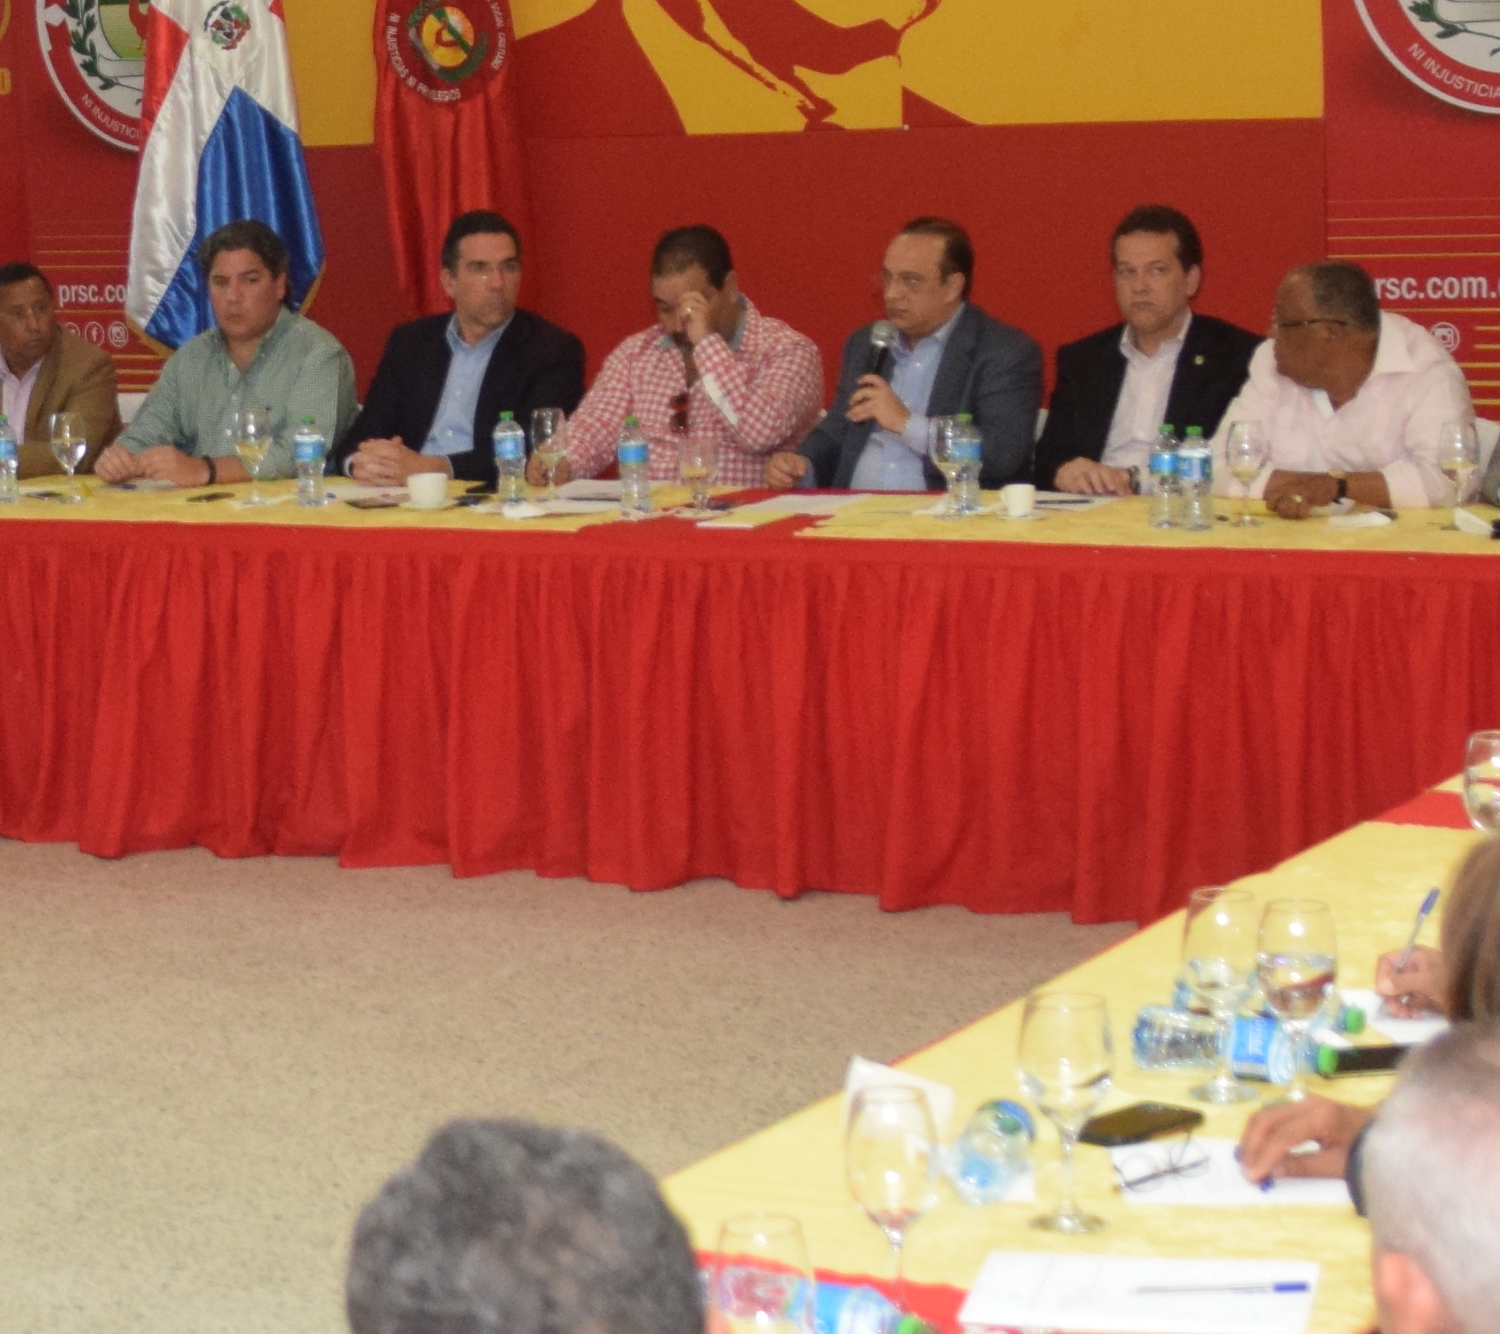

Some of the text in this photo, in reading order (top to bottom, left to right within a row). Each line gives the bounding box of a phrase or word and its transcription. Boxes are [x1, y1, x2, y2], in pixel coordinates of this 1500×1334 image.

[1407, 42, 1426, 61] NI
[82, 92, 141, 140] NI INJUSTICI
[59, 284, 127, 308] prsc.co
